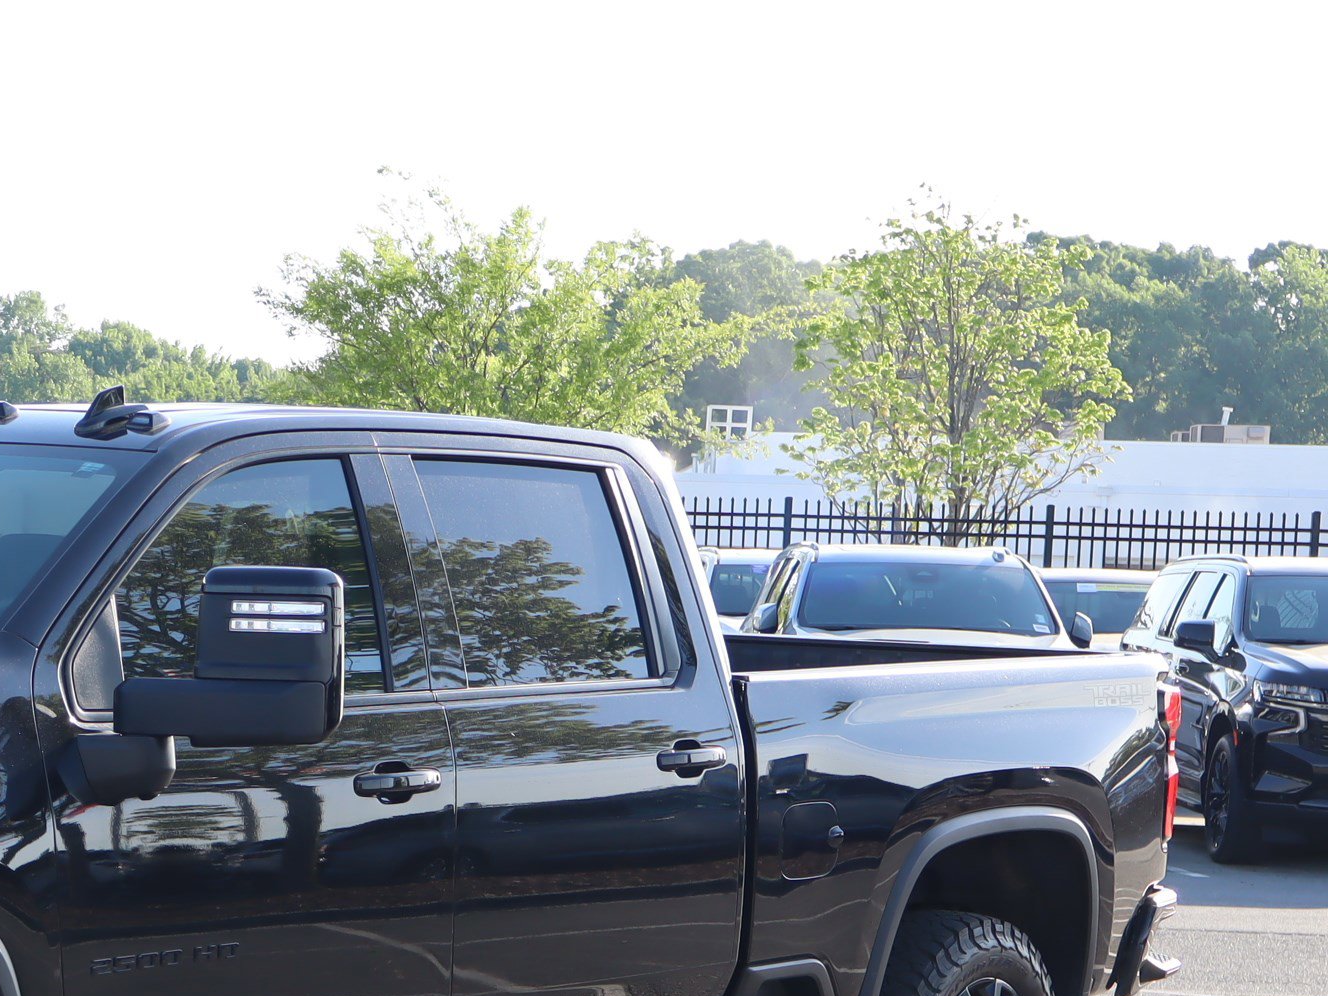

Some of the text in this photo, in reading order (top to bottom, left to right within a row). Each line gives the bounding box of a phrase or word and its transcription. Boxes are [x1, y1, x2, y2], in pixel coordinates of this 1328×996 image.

[1083, 683, 1151, 697] TRAIL
[1094, 696, 1144, 707] BOSS
[90, 941, 240, 975] 2500 HD
